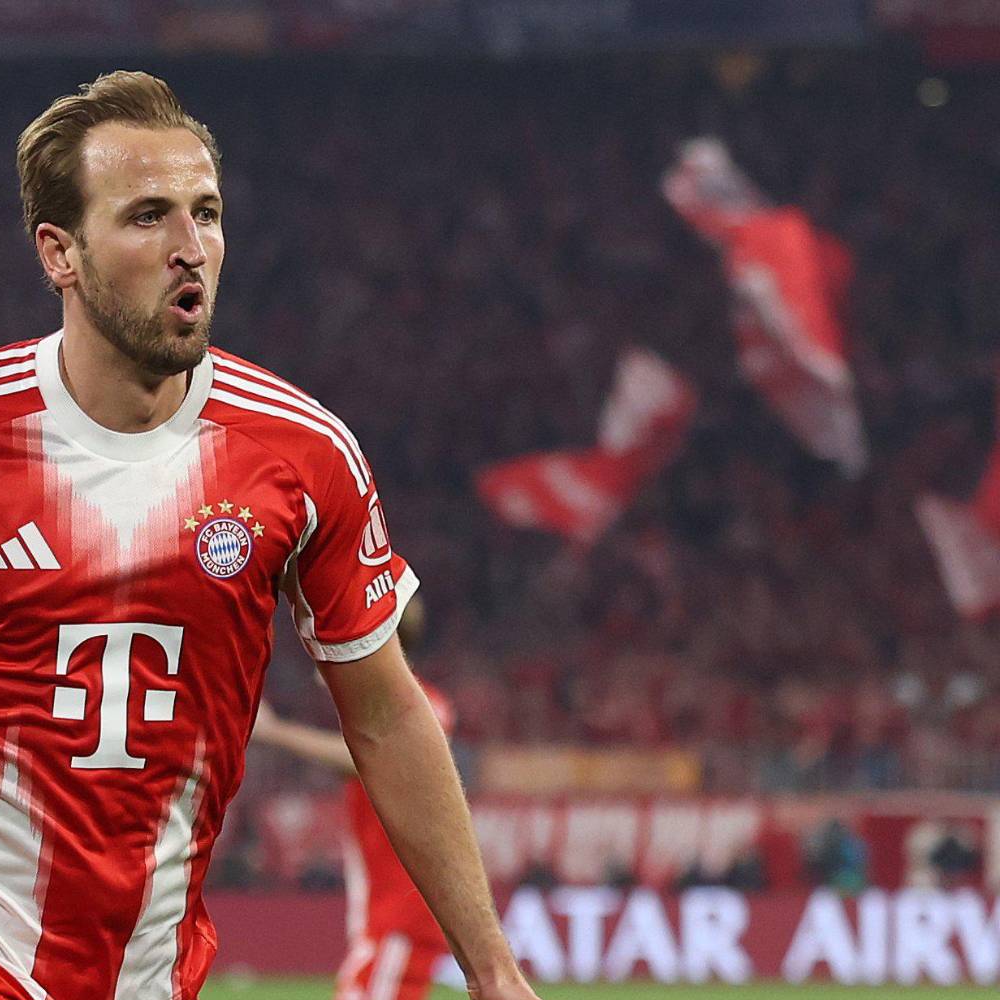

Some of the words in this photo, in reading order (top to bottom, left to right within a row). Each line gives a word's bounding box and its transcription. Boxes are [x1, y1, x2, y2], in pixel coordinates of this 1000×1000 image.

[202, 529, 213, 544] FC
[214, 522, 248, 547] BAYERN
[55, 622, 184, 769] T
[430, 884, 754, 985] ATAR
